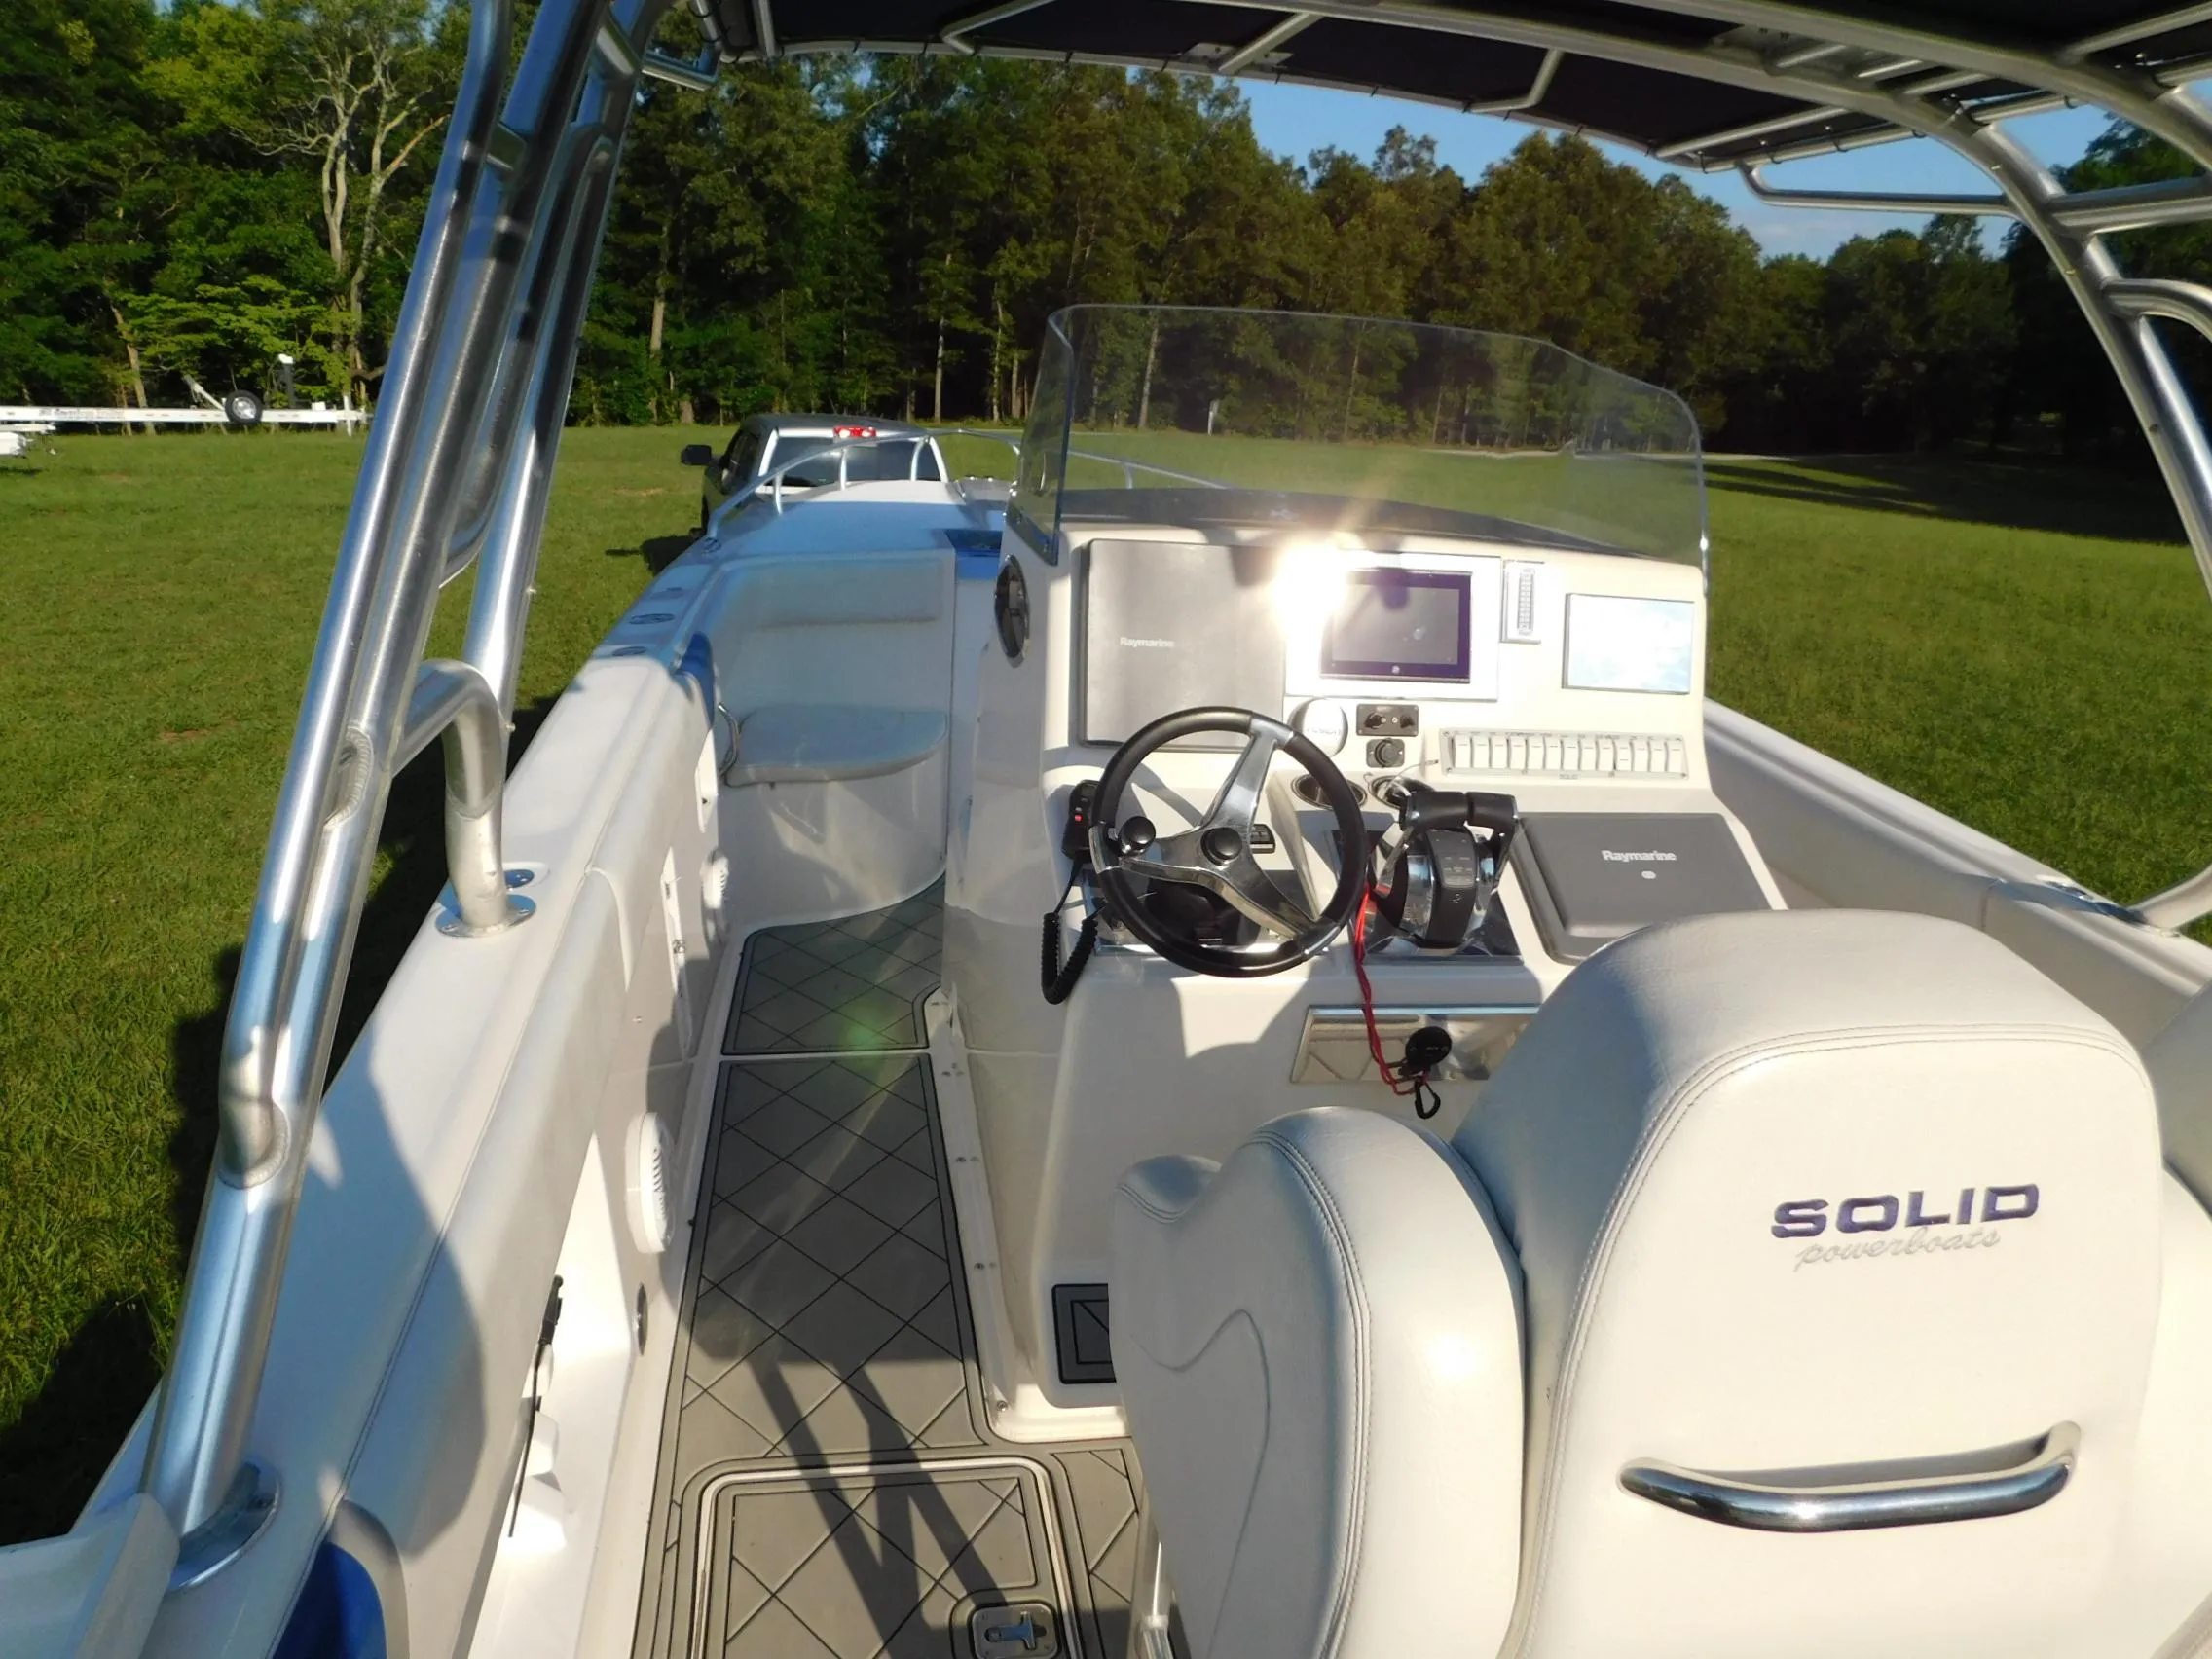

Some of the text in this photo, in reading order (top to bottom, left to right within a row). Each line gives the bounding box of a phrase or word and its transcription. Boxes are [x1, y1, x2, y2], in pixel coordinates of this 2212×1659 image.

[1602, 850, 1677, 863] Raymarine
[1770, 1183, 2040, 1239] SOLID
[1793, 1226, 2001, 1273] powerboats
